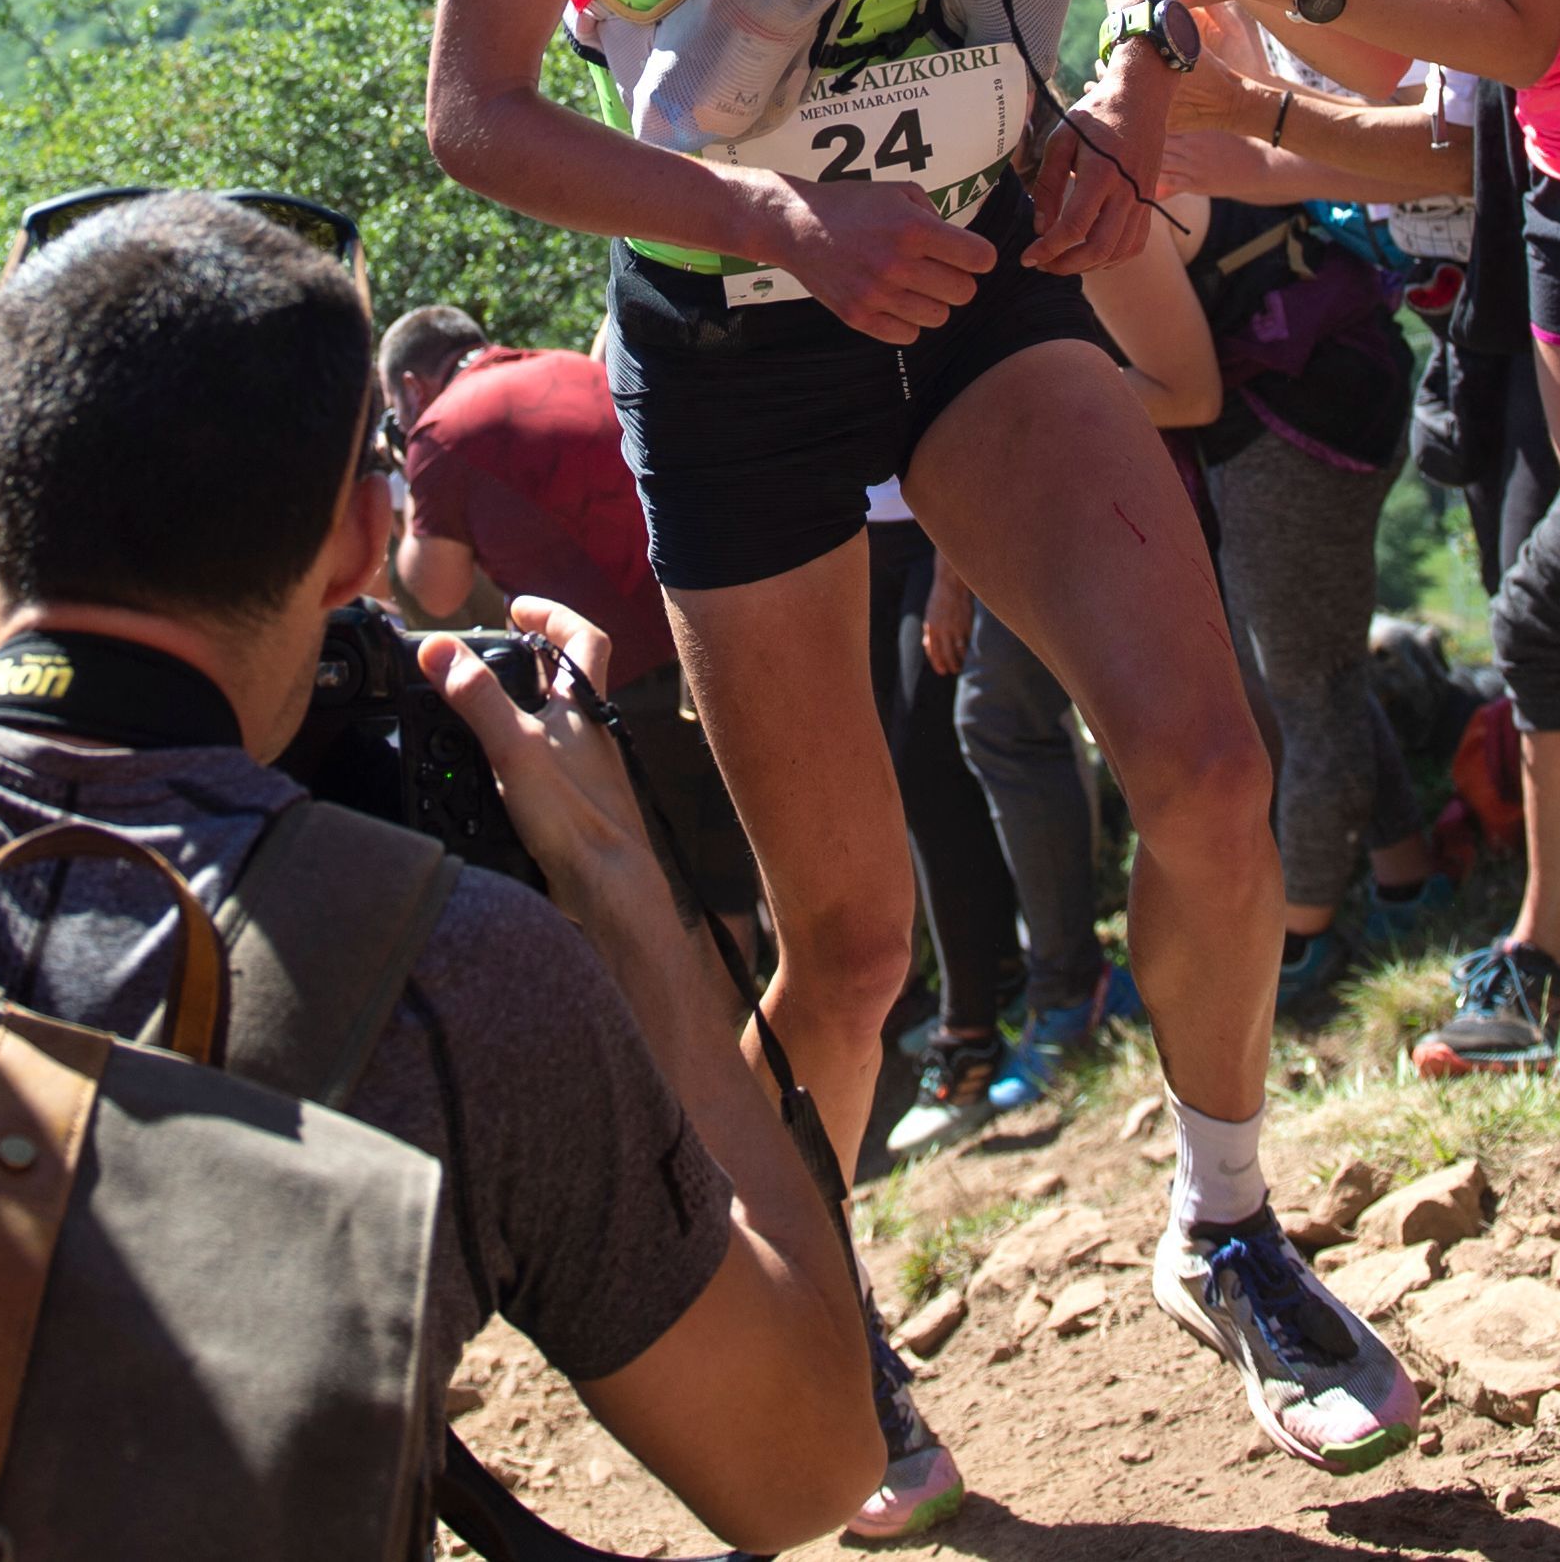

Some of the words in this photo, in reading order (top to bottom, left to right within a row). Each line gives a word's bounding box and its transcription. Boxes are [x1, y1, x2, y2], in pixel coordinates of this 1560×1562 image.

[861, 46, 1001, 92] AIZKORRI
[993, 78, 1003, 91] 29
[800, 102, 849, 121] MENDI
[852, 87, 930, 111] MARATOIA
[811, 108, 933, 182] 24
